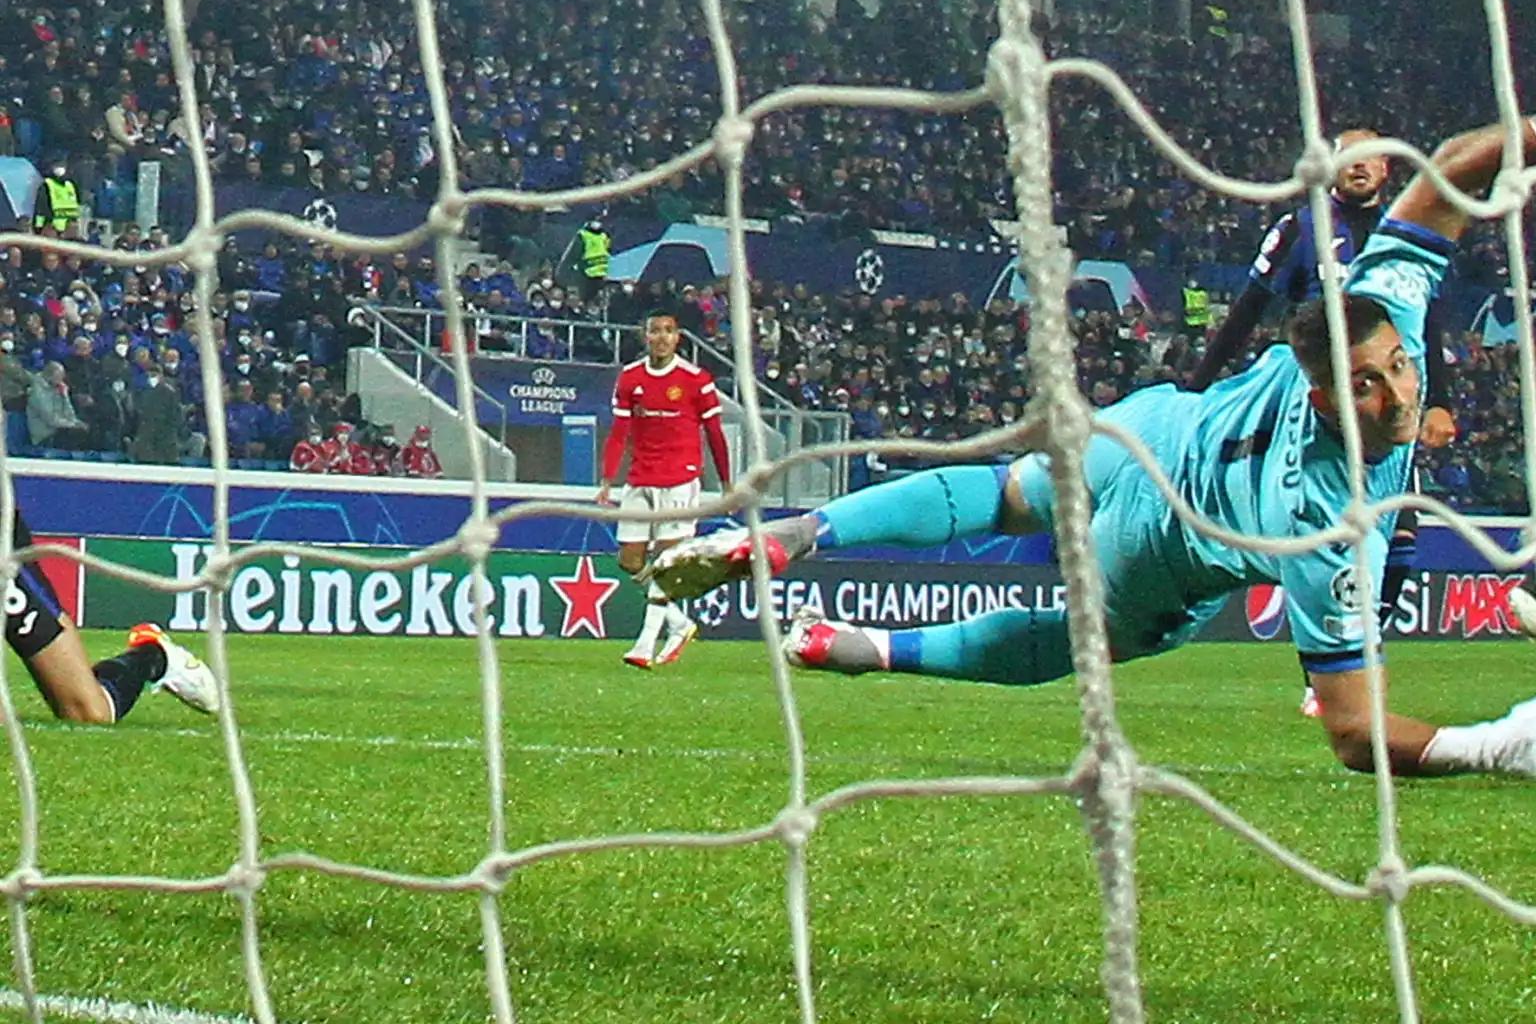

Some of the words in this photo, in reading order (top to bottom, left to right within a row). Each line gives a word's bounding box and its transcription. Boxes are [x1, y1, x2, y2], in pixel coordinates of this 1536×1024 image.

[509, 384, 577, 400] CHAMPIONS
[520, 399, 565, 414] LEAGUE
[168, 542, 545, 637] Heineken
[738, 578, 825, 621] UEFA
[835, 582, 1025, 623] CHAMPIONS
[1437, 573, 1527, 639] MAX
